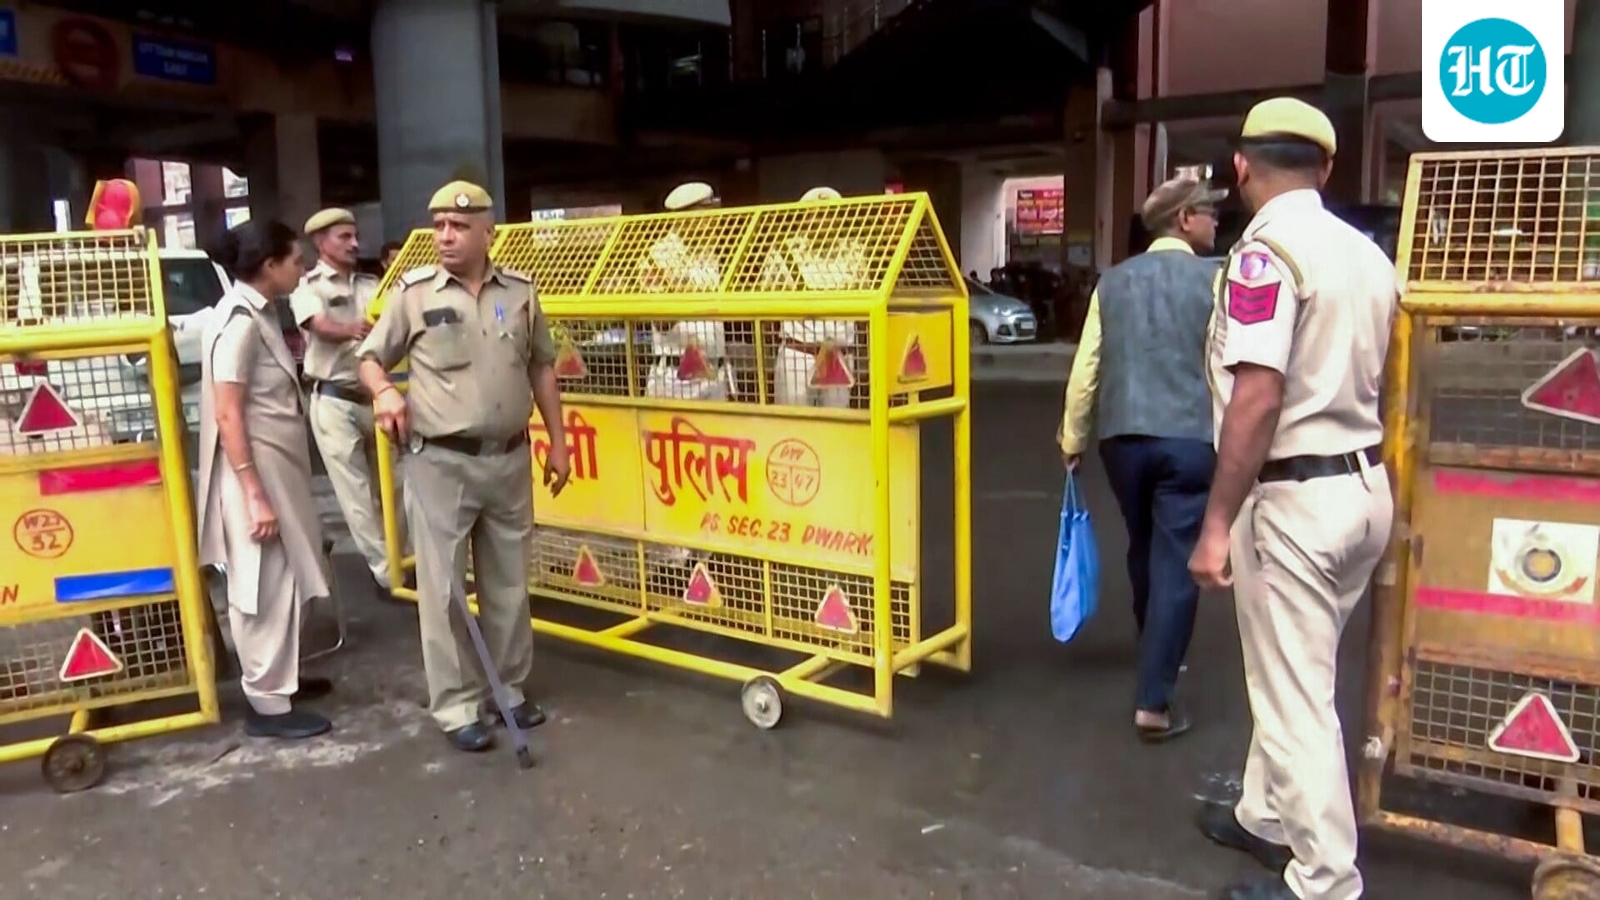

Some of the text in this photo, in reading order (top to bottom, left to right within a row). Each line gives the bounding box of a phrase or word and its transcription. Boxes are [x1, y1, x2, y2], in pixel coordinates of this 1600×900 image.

[642, 415, 756, 507] पुलिस
[767, 520, 791, 543] 23
[802, 525, 873, 556] DWARK
